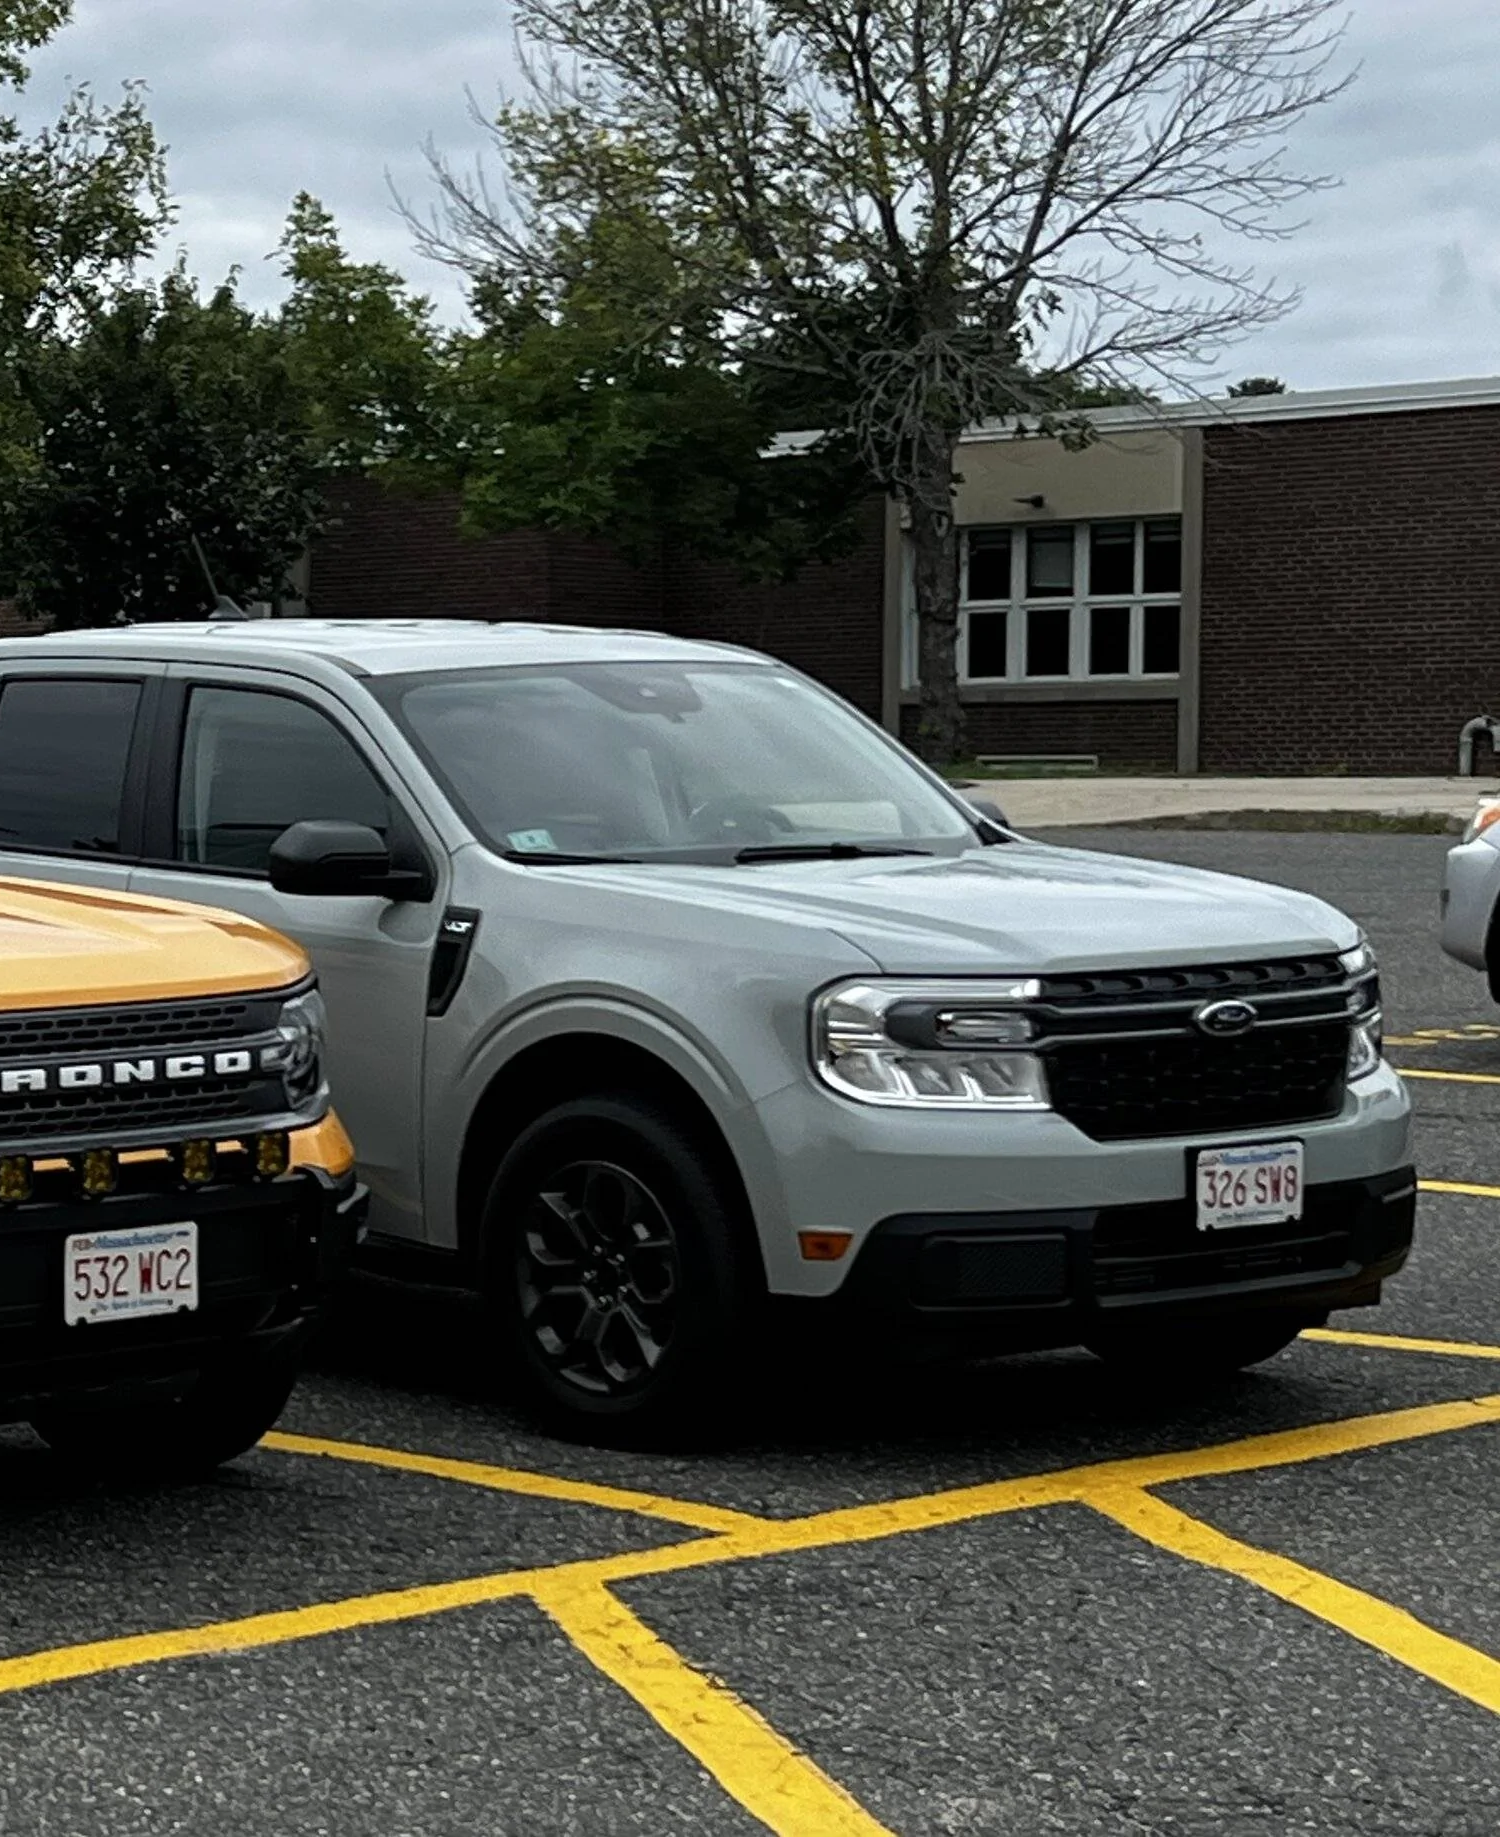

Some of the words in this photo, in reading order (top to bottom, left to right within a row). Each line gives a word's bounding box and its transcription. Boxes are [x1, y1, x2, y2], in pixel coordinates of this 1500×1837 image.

[1203, 1168, 1247, 1209] 326
[1254, 1165, 1297, 1204] SW8
[74, 1255, 129, 1300] 532
[138, 1248, 191, 1293] WC2
